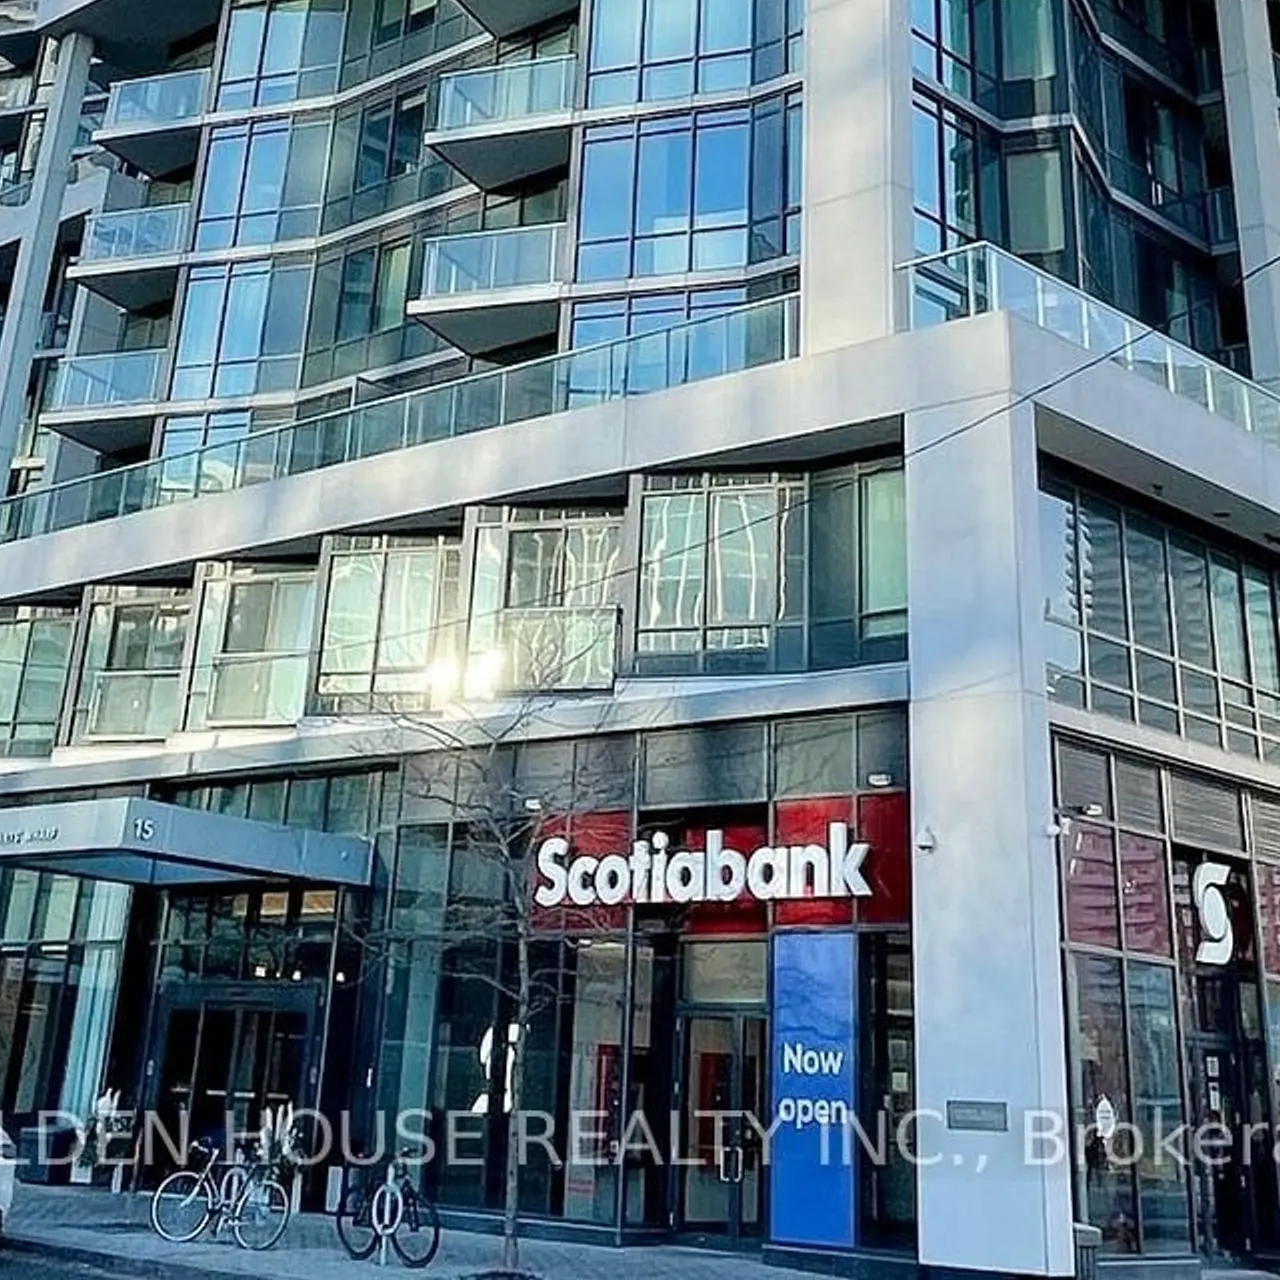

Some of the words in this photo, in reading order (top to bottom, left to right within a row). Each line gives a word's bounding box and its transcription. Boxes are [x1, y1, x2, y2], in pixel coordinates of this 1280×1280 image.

[133, 818, 155, 840] 15
[535, 822, 873, 907] Scotiabank
[783, 1043, 843, 1076] Now
[779, 1096, 848, 1129] open
